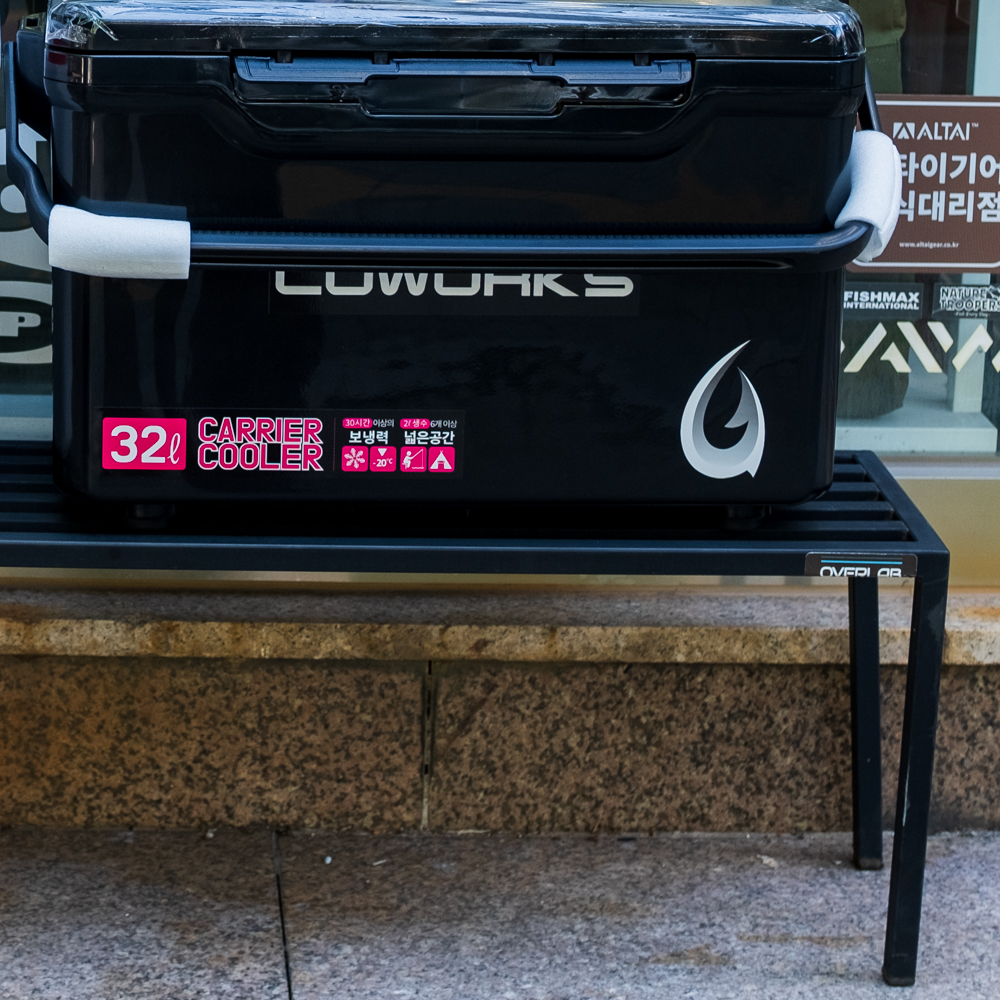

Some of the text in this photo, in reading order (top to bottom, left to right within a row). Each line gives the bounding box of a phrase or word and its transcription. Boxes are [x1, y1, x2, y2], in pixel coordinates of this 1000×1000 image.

[917, 122, 970, 141] ALTAI
[843, 290, 920, 303] FISHMAX
[940, 286, 987, 301] NATURE
[843, 302, 920, 310] INTERNATIONAL
[198, 416, 324, 444] CARRIER
[345, 419, 371, 427] 30시간
[348, 430, 389, 445] 보냉력
[198, 443, 324, 471] COOLER
